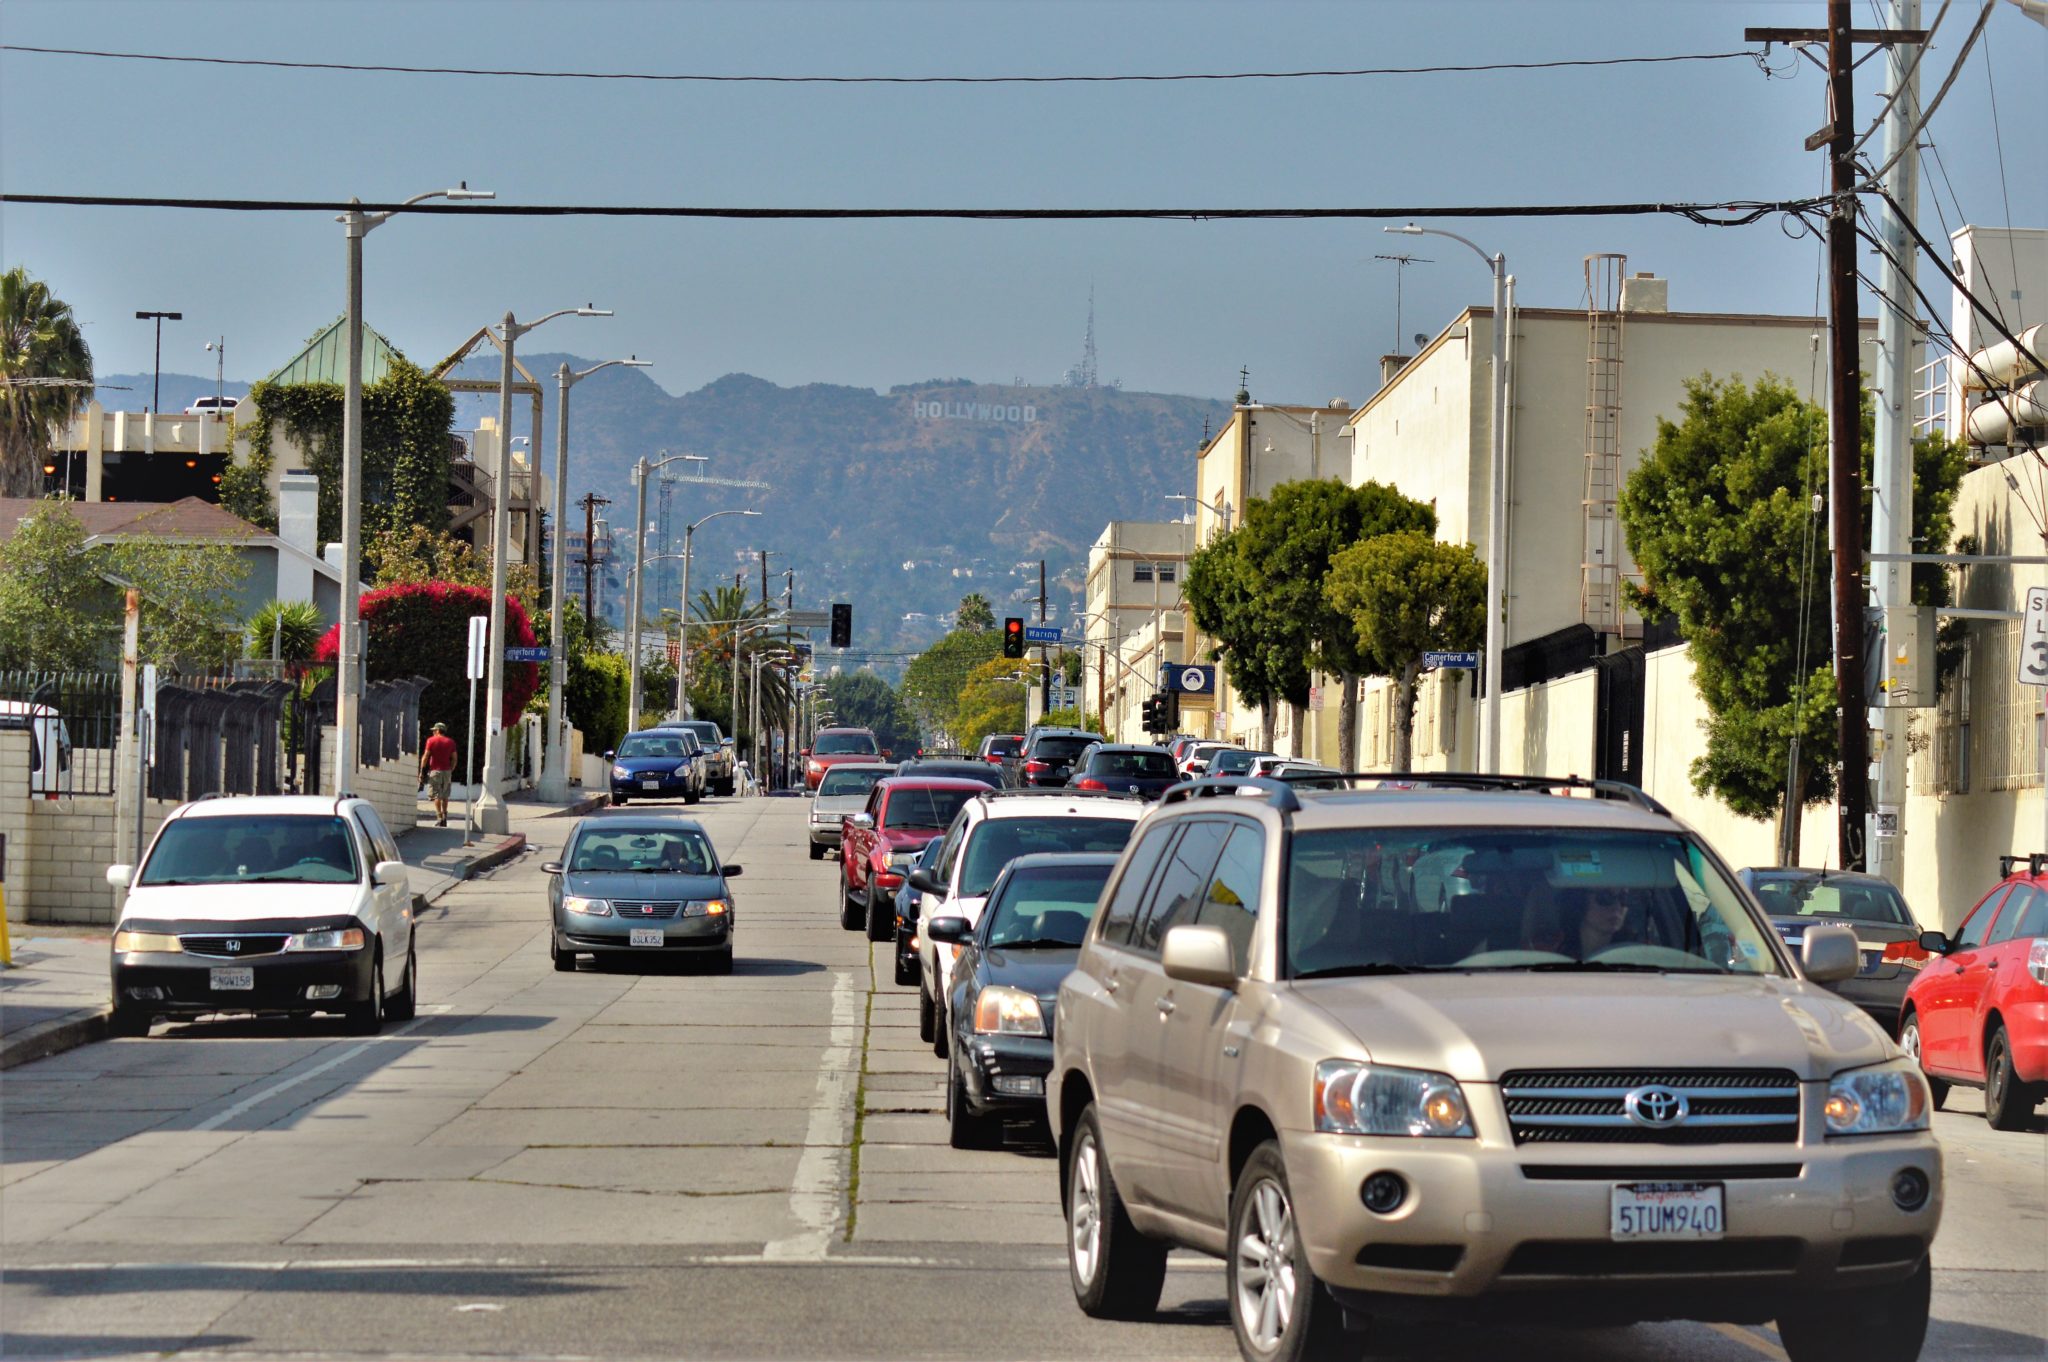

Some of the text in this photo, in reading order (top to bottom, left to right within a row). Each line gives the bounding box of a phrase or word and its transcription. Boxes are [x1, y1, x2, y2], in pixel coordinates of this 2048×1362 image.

[913, 401, 1037, 422] HOLLYWOOD
[1028, 629, 1058, 640] Waring
[1424, 652, 1475, 662] Camerford Av
[1620, 1205, 1717, 1233] 5TUM940
